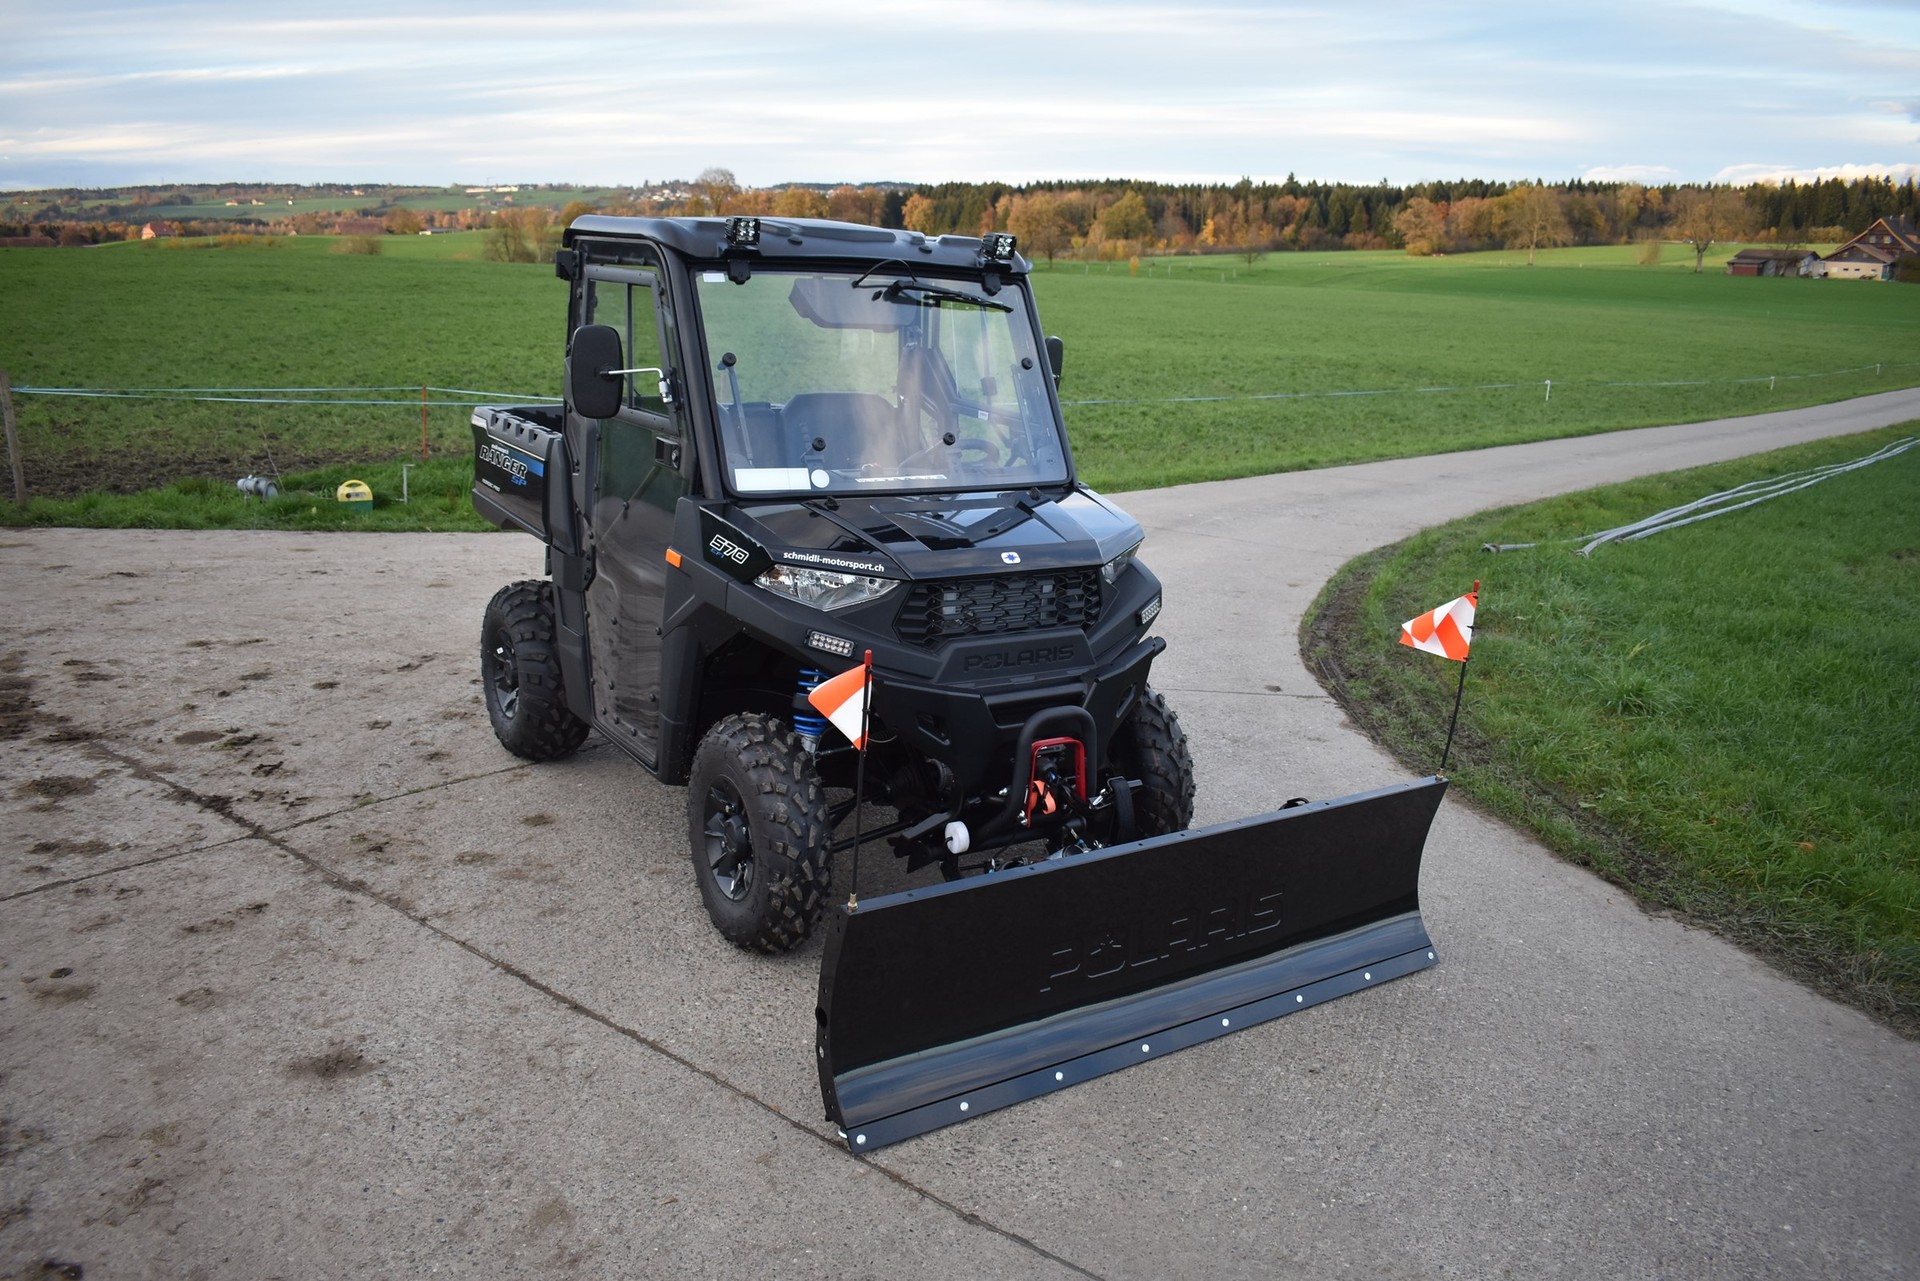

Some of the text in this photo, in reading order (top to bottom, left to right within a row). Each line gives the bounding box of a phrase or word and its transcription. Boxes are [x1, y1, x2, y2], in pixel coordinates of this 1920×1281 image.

[479, 444, 528, 479] RANGER
[511, 475, 527, 486] SP
[709, 534, 750, 565] 570
[783, 552, 885, 572] schmidli-motorsport.ch
[963, 644, 1074, 673] POLARIS
[1039, 887, 1284, 993] POLARIS
